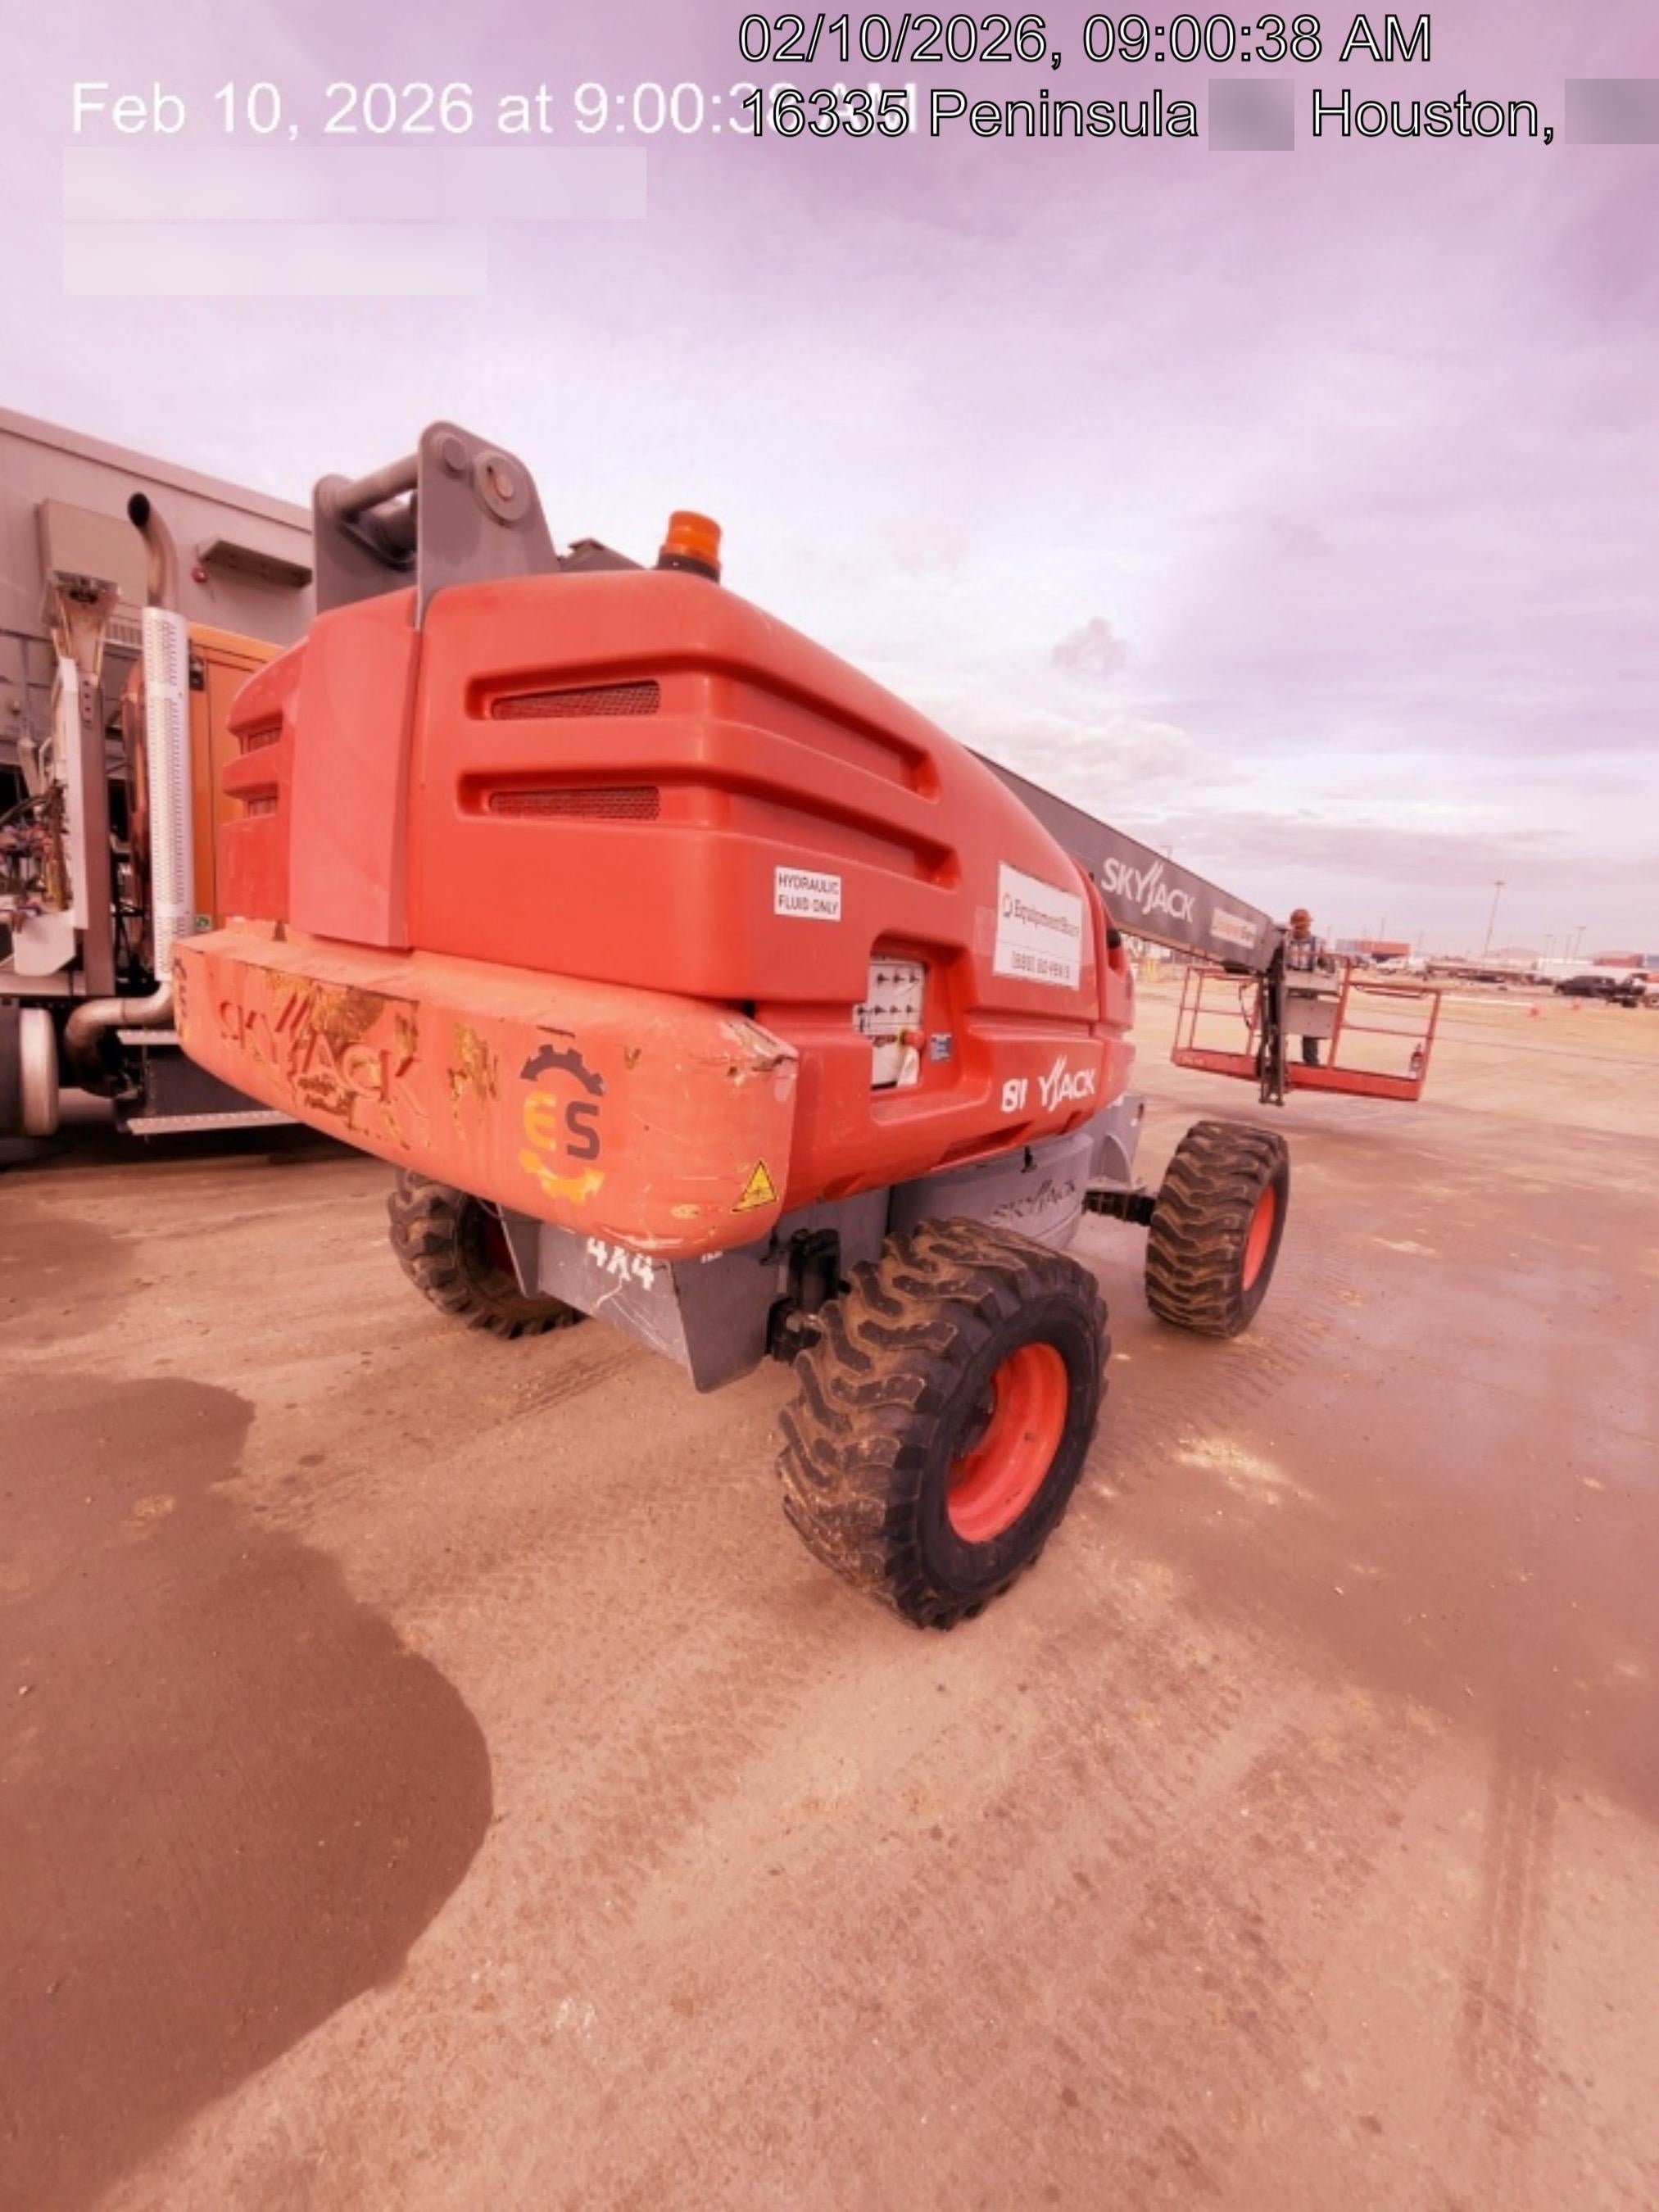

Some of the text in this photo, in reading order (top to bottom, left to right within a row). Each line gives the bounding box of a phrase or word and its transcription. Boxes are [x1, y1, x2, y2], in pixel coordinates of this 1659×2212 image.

[778, 873, 839, 895] HYDRAULIC
[1100, 857, 1195, 923] SKYJACK
[778, 894, 839, 914] FLUID ONLY
